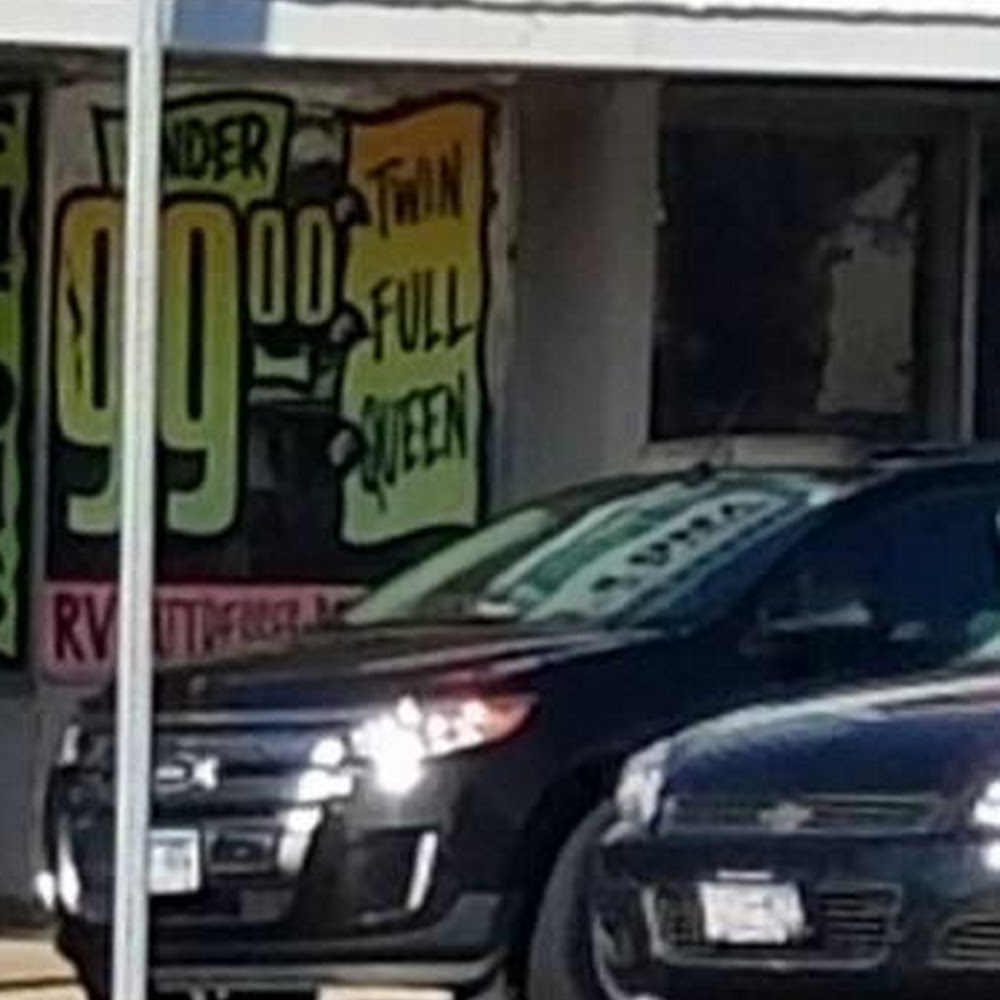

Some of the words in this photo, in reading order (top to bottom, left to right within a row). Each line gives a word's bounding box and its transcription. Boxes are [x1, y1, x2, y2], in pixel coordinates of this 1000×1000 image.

[122, 112, 270, 182] NDER
[370, 265, 474, 364] FULL
[360, 370, 468, 512] QUEEN
